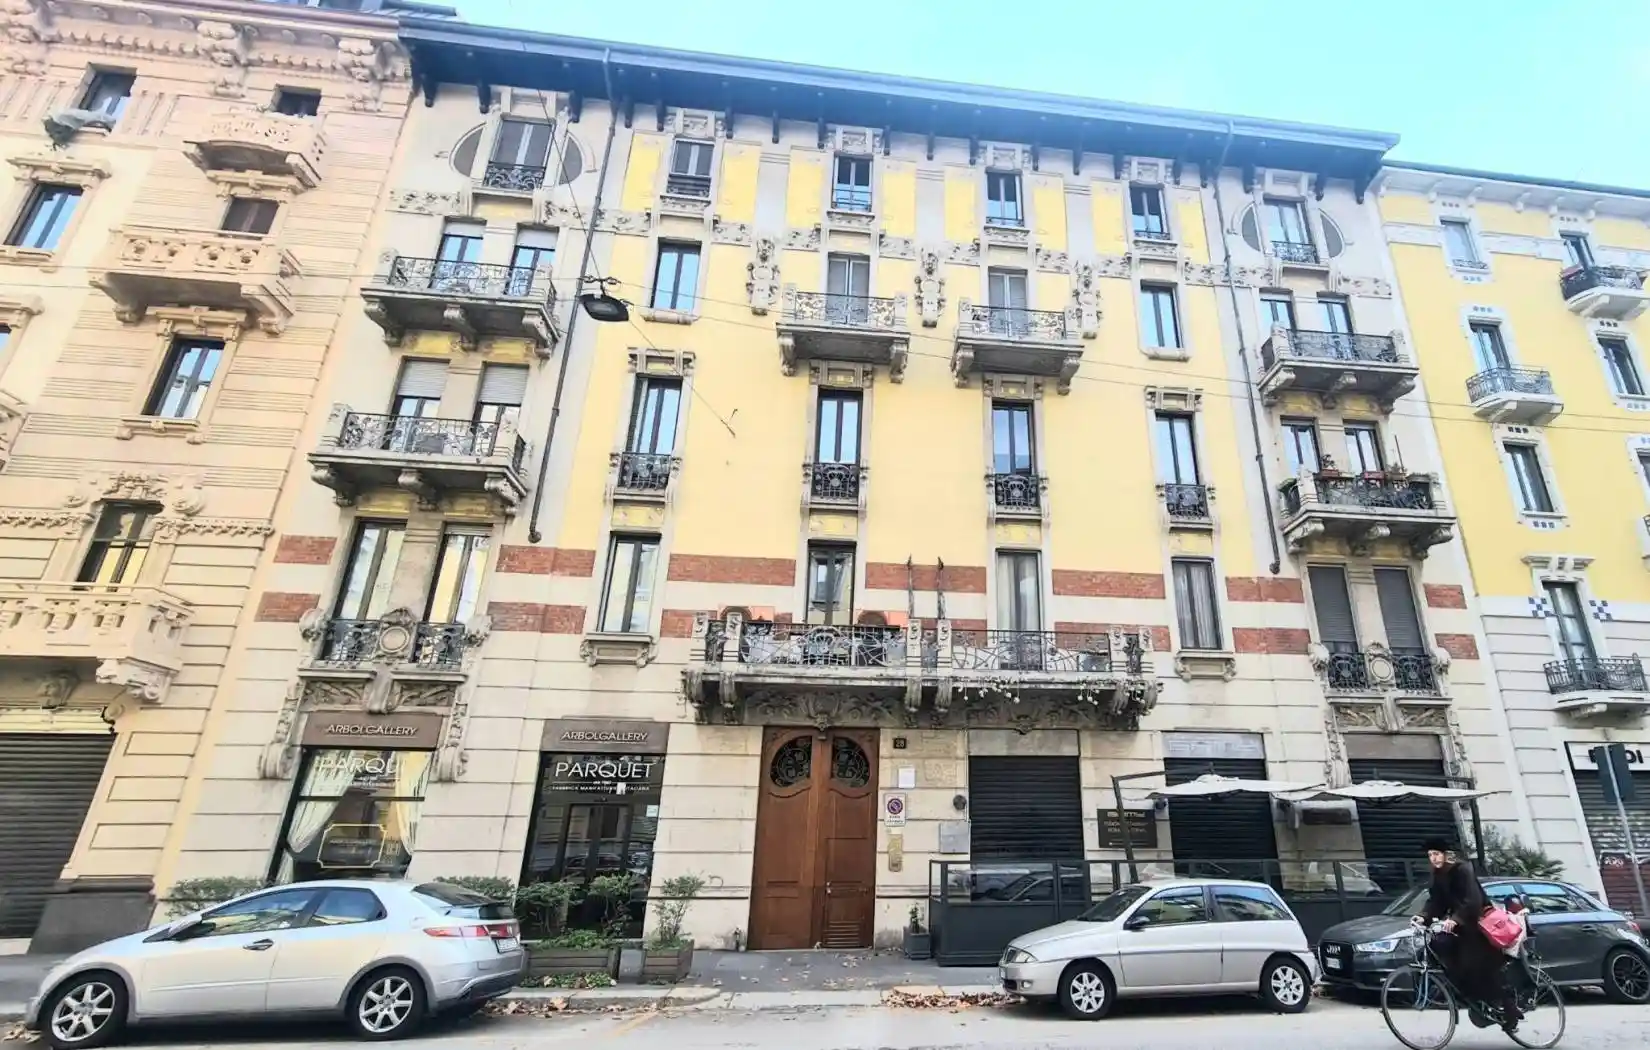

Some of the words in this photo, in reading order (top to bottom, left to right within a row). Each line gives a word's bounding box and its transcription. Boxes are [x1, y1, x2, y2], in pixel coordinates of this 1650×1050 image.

[325, 724, 417, 736] ARBOLGALLERY
[560, 731, 648, 741] ARBOLGALLERY
[555, 762, 656, 778] PARQUET
